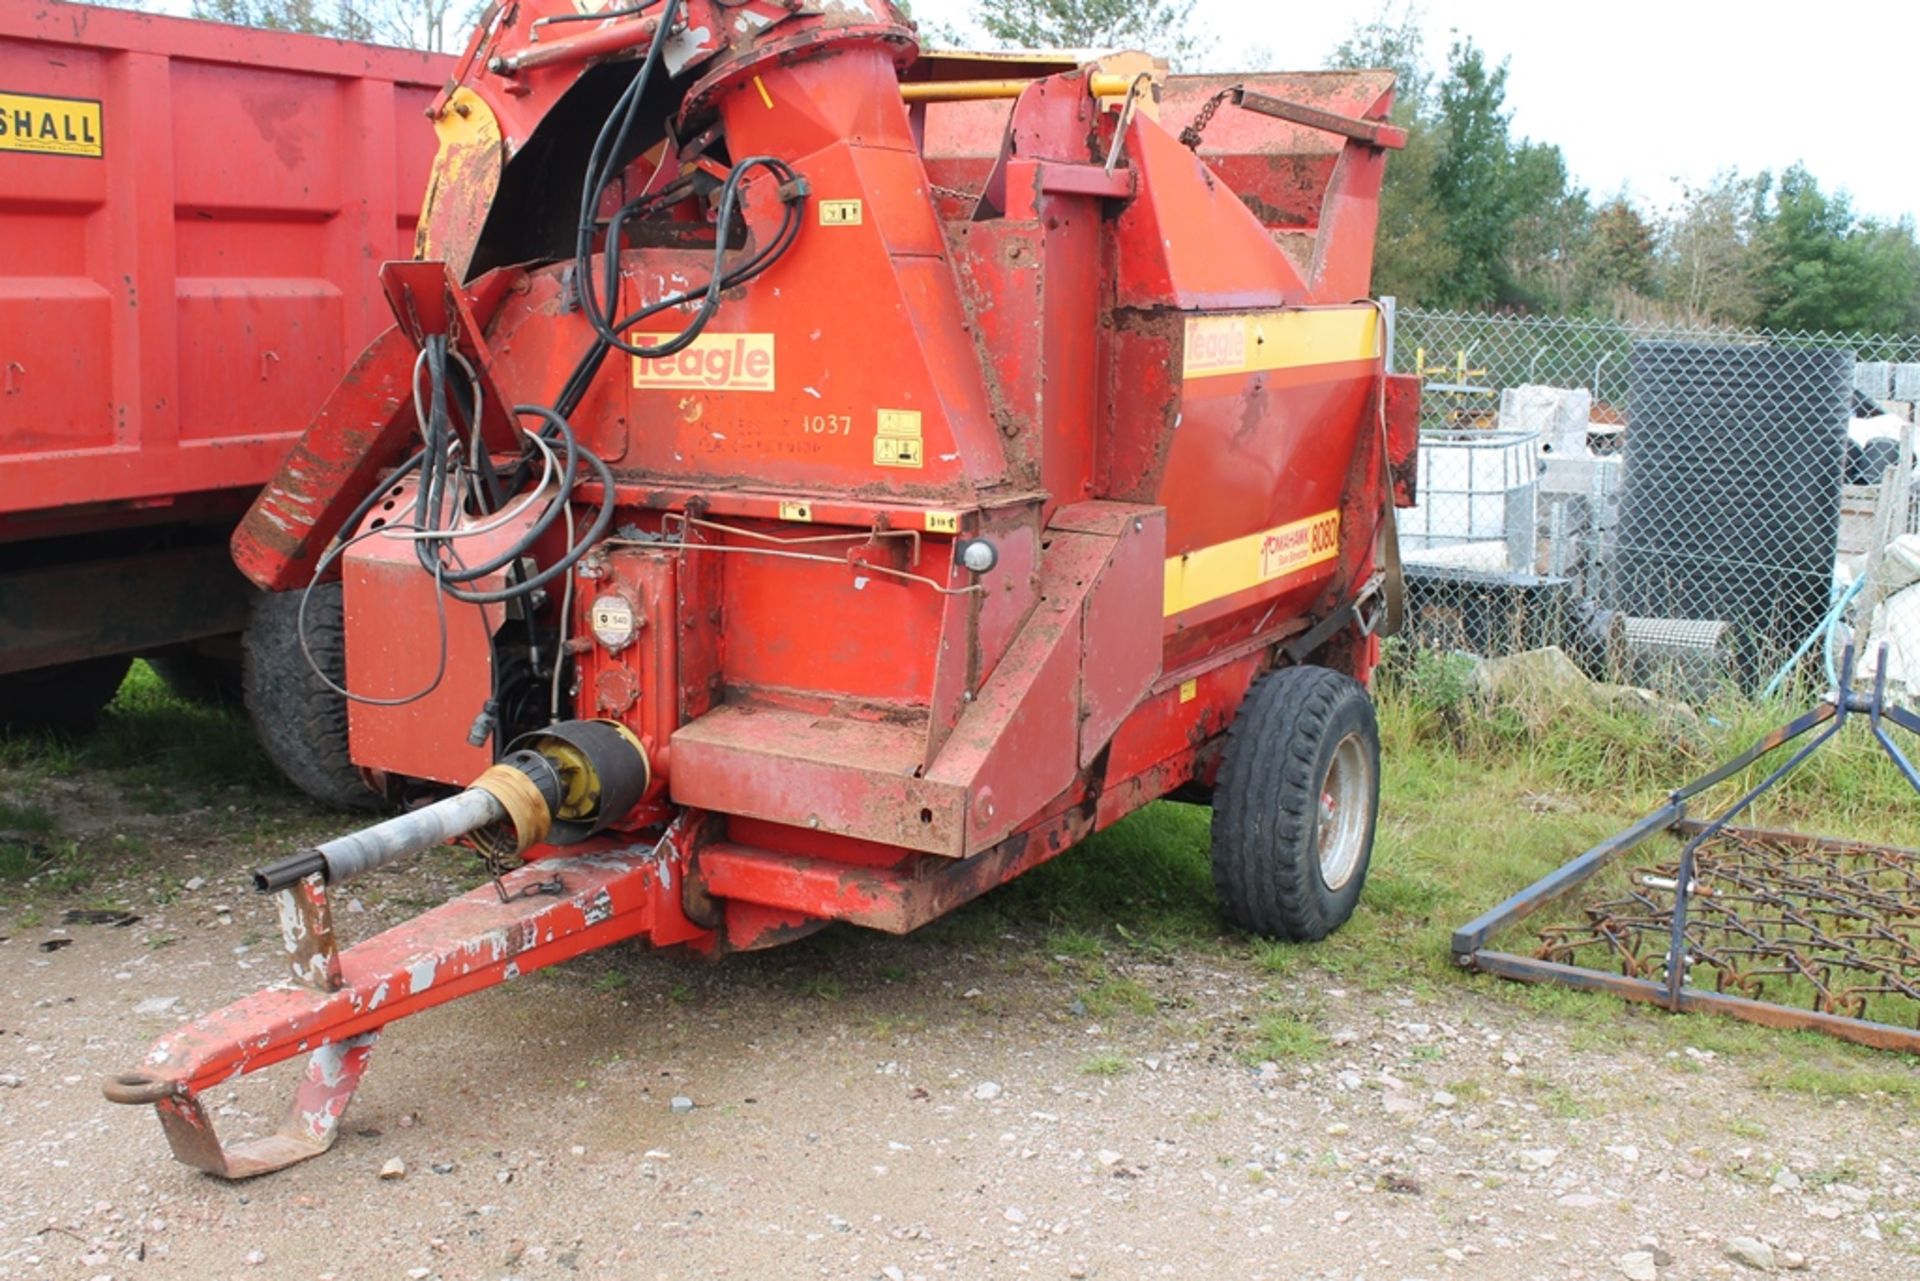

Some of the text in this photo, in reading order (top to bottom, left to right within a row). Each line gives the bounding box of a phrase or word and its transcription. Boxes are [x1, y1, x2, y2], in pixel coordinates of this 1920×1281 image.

[636, 336, 770, 386] Teagle
[803, 415, 851, 435] 1037
[1312, 517, 1338, 554] 8080
